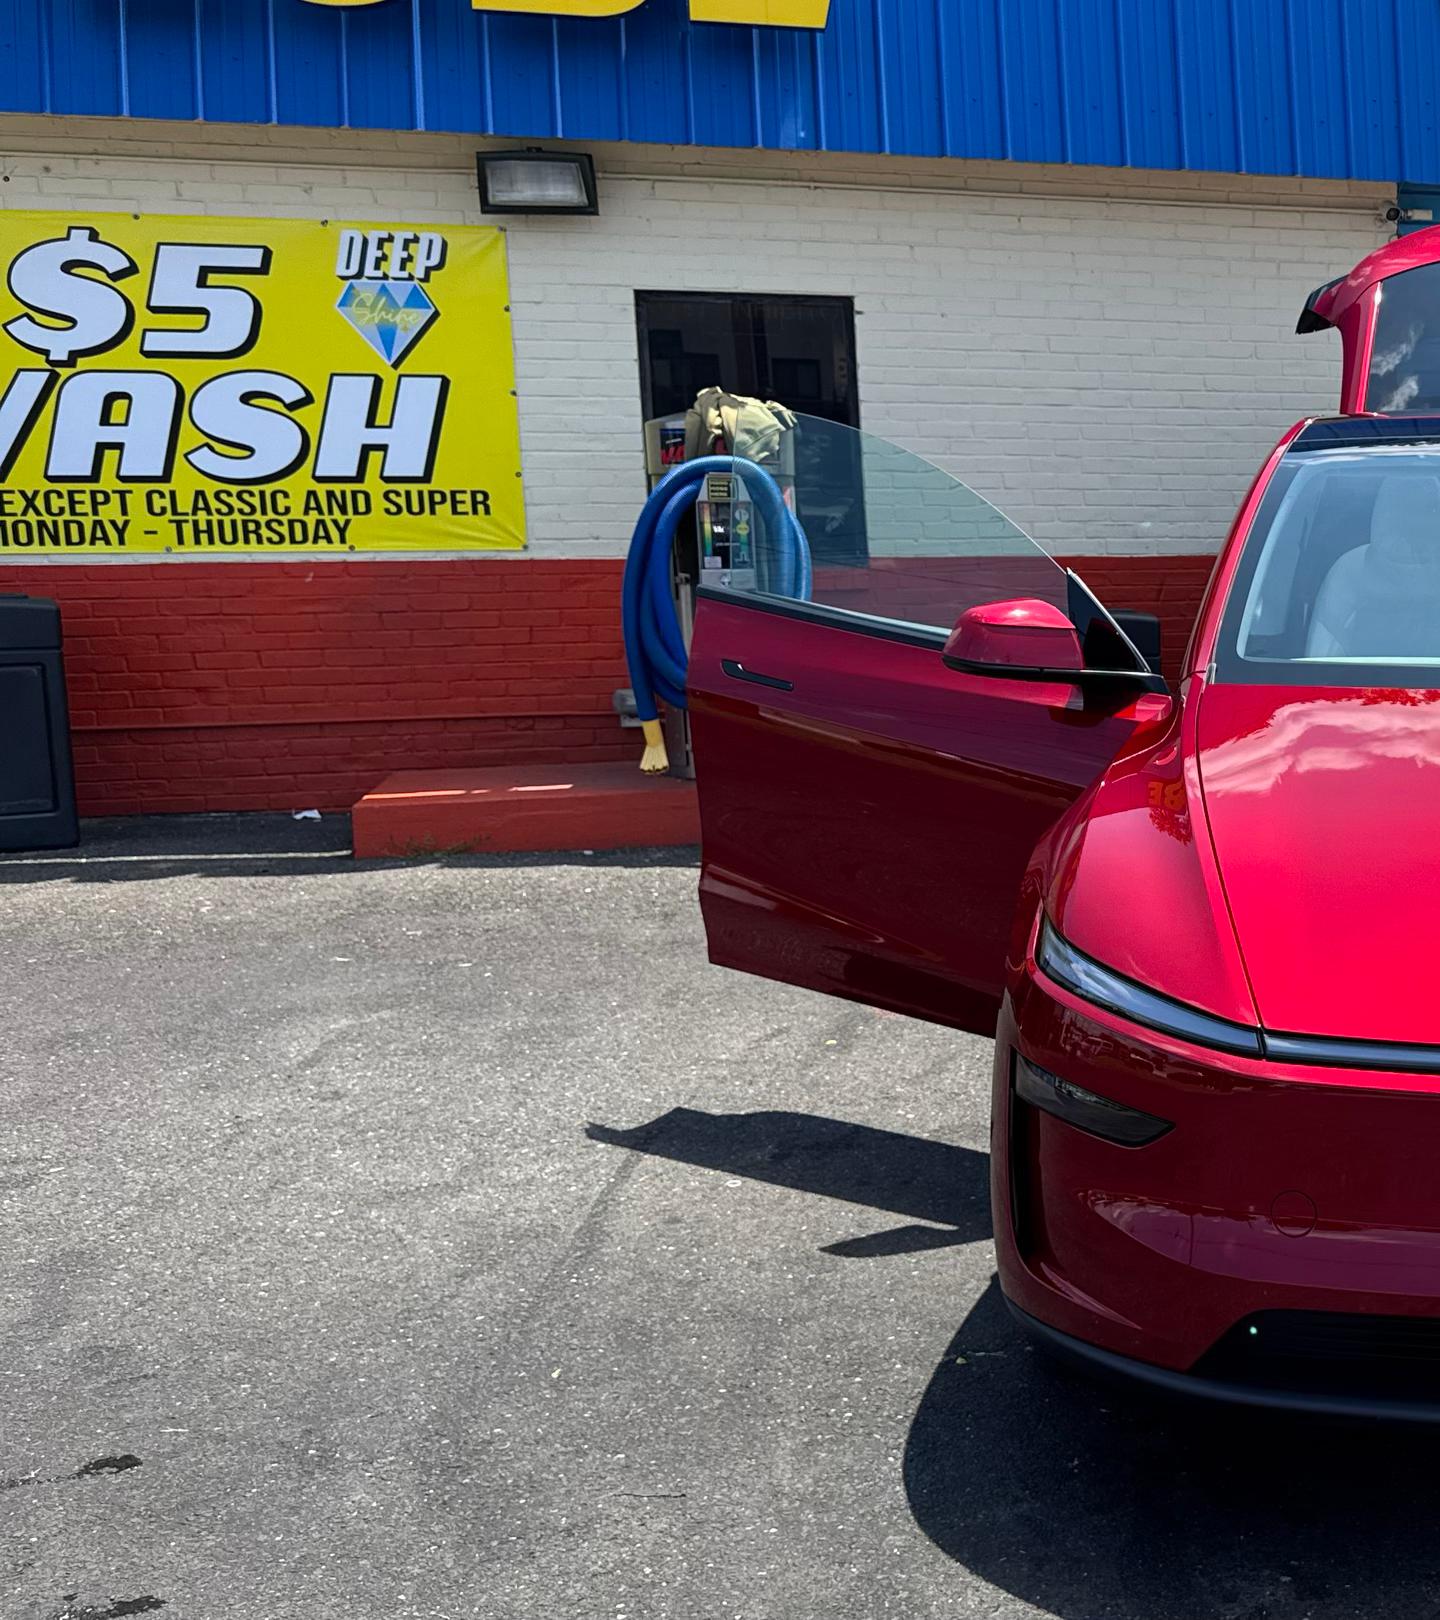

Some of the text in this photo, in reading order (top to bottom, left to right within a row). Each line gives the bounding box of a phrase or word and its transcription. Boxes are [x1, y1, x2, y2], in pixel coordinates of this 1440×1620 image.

[336, 230, 448, 283] DEEP
[2, 226, 272, 367] $5
[352, 292, 420, 325] Shine
[0, 489, 492, 517] EXCEPT CLASSIC AND SUPER
[168, 518, 352, 546] THURSDAY
